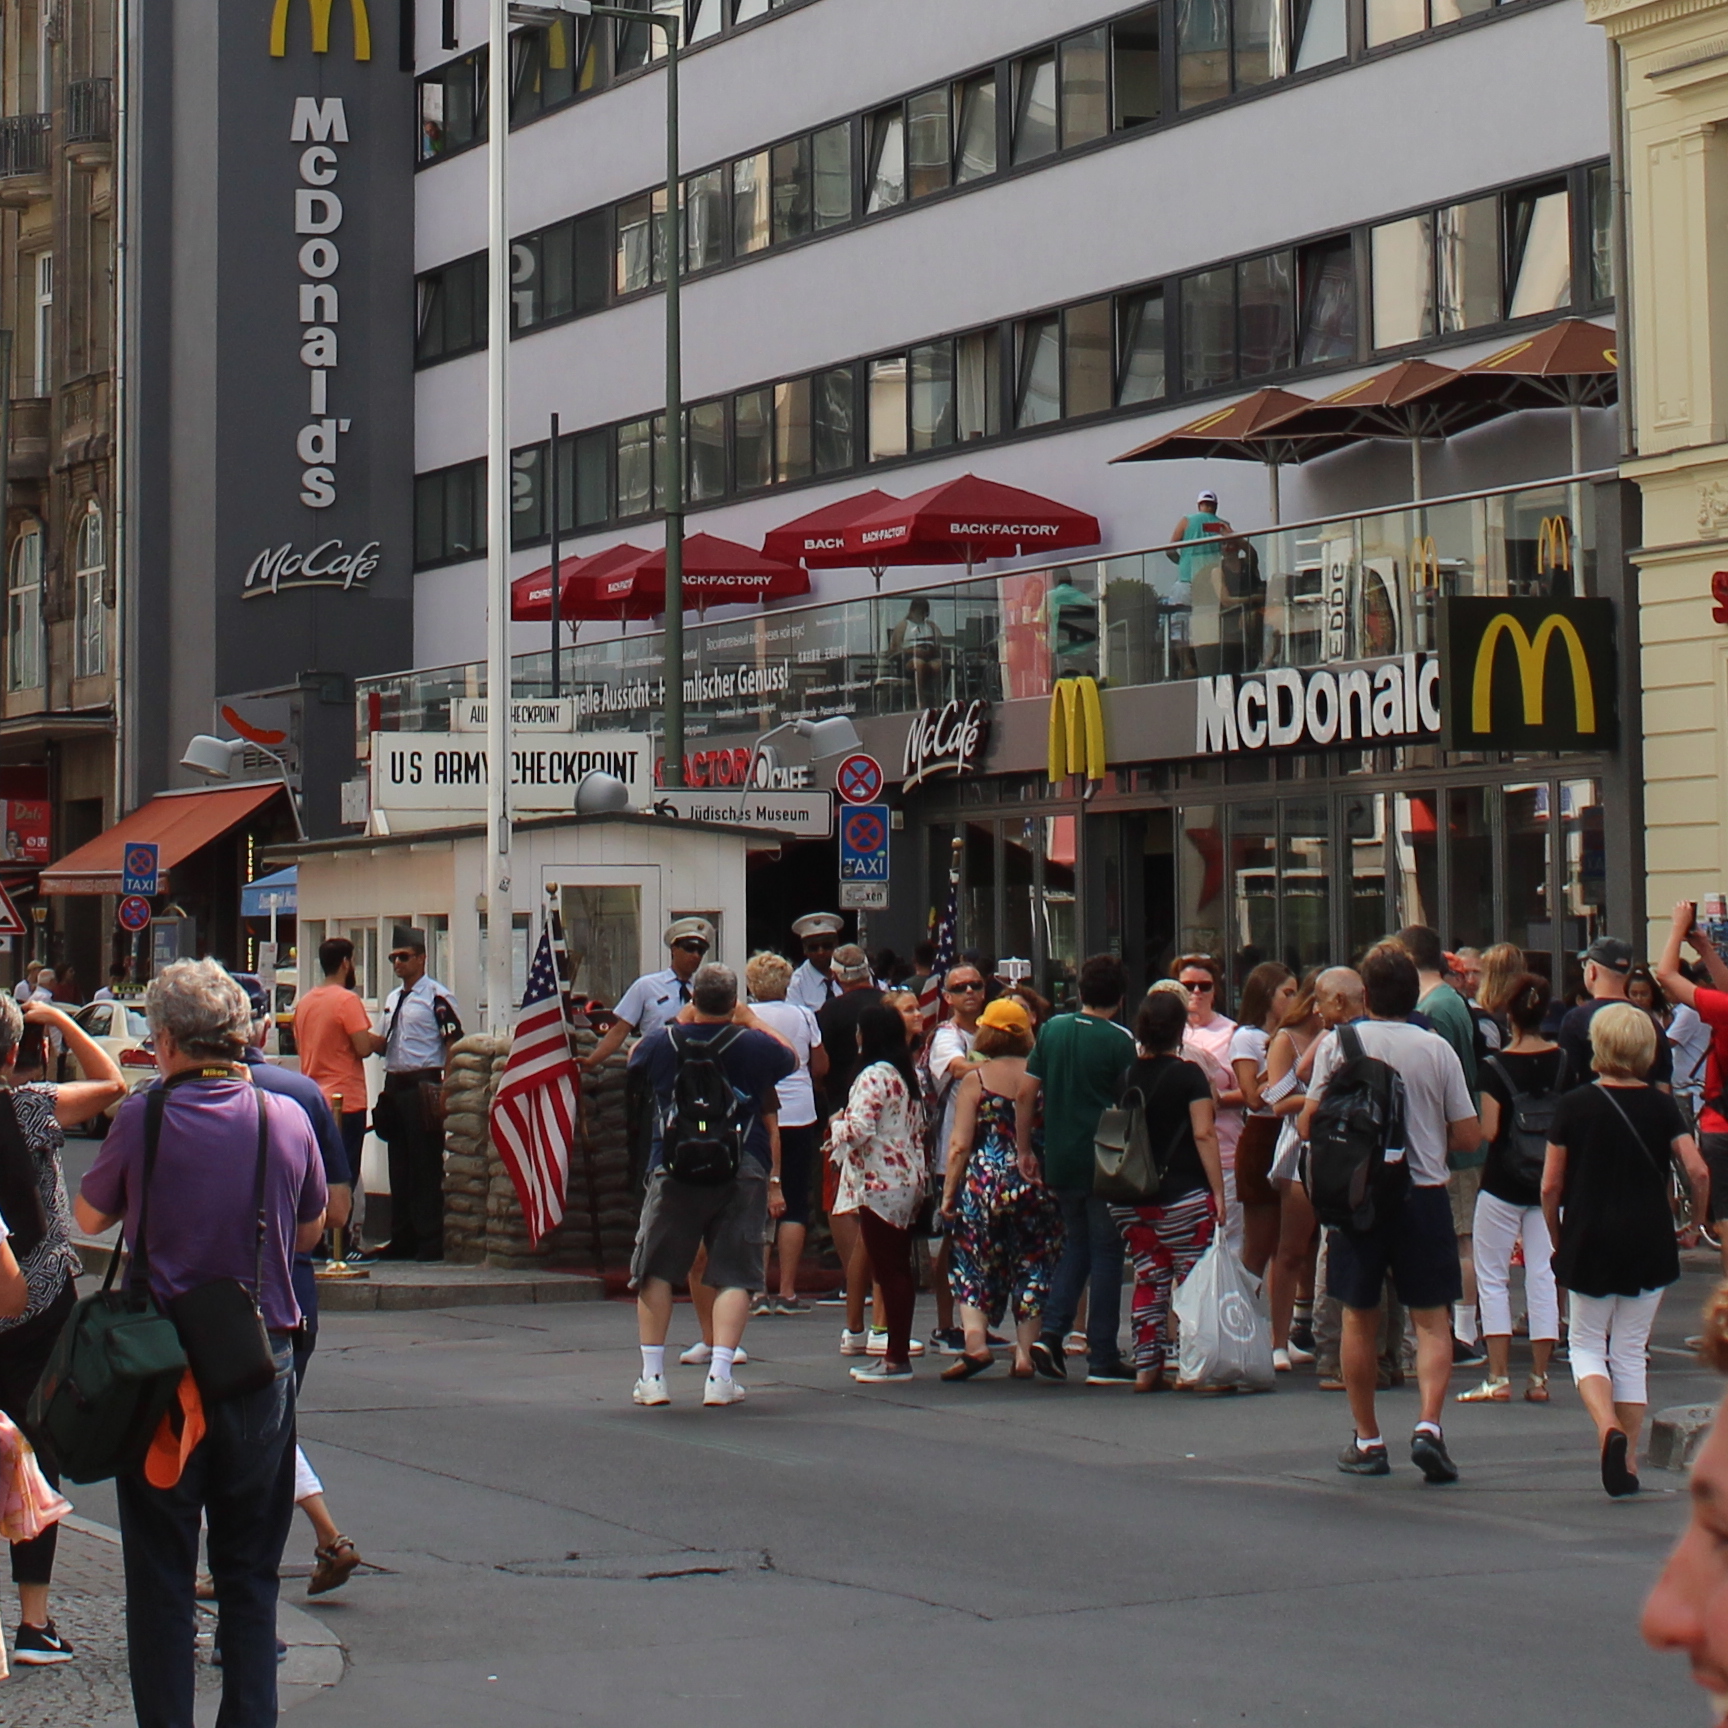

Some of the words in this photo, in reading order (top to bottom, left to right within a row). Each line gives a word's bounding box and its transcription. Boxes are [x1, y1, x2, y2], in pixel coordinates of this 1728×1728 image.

[290, 96, 351, 508] McDonald's
[244, 538, 380, 595] McCafé
[602, 677, 650, 712] Aussicht
[737, 658, 789, 695] Genuss!
[511, 705, 561, 723] HECKPOINT
[902, 698, 981, 784] McCafé
[690, 805, 751, 822] Jüdisches
[756, 805, 810, 822] Museum
[845, 858, 883, 875] TAXI
[126, 878, 154, 891] TAXI
[201, 1067, 228, 1078] Nikon
